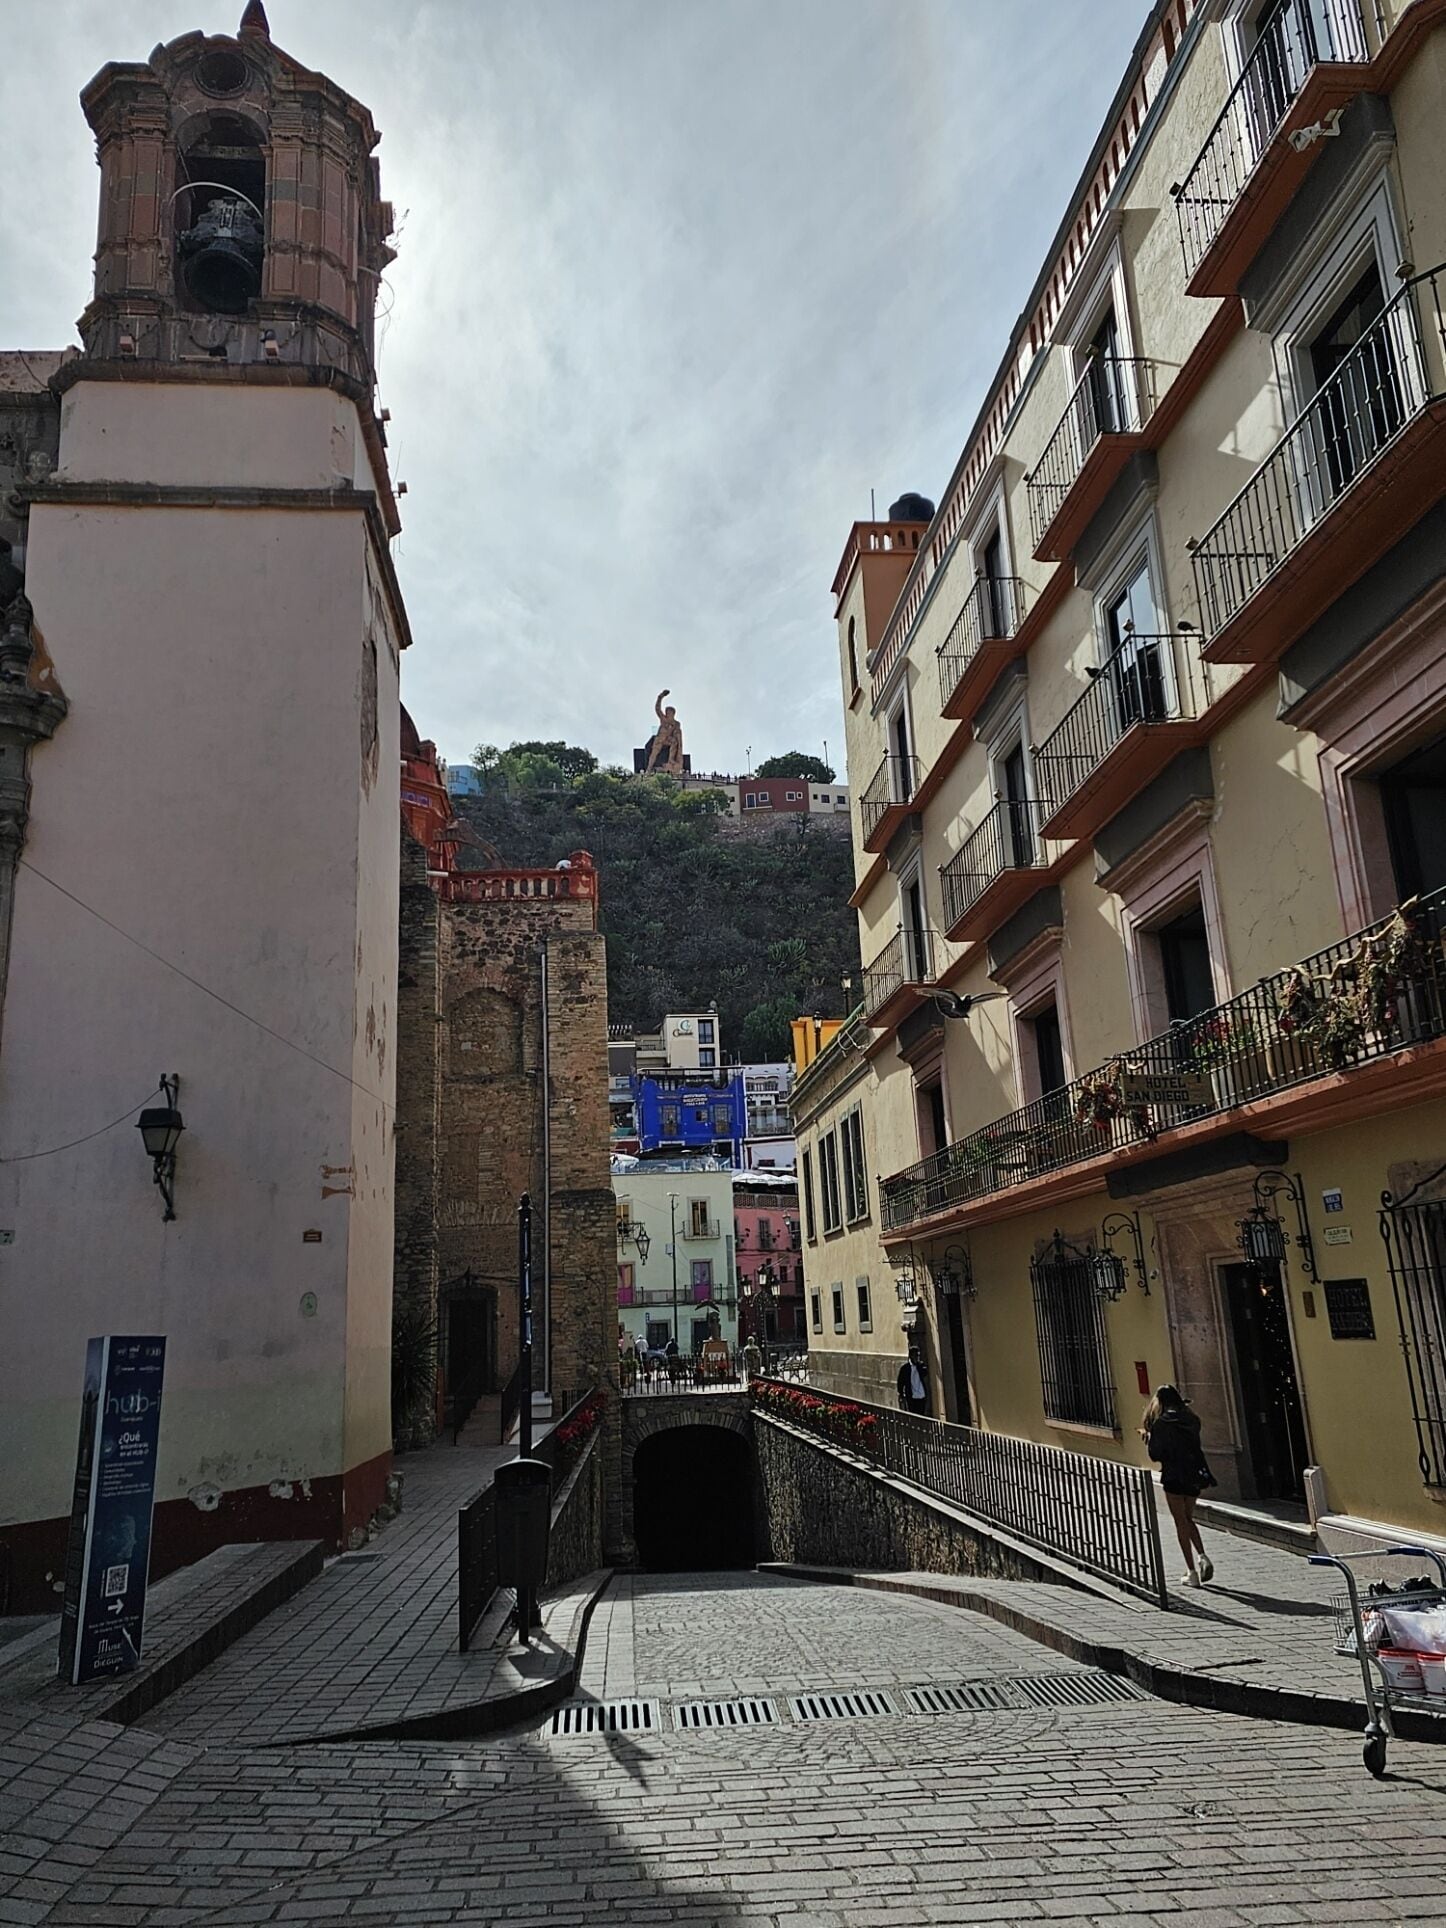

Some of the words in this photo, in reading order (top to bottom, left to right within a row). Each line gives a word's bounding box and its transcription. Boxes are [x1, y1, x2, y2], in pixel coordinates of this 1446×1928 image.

[1146, 1077, 1186, 1088] HOTEL
[1126, 1091, 1151, 1101] SAN
[1154, 1090, 1190, 1102] DIEGO
[105, 1388, 162, 1415] hub-i
[118, 1430, 141, 1445] ¿Qué
